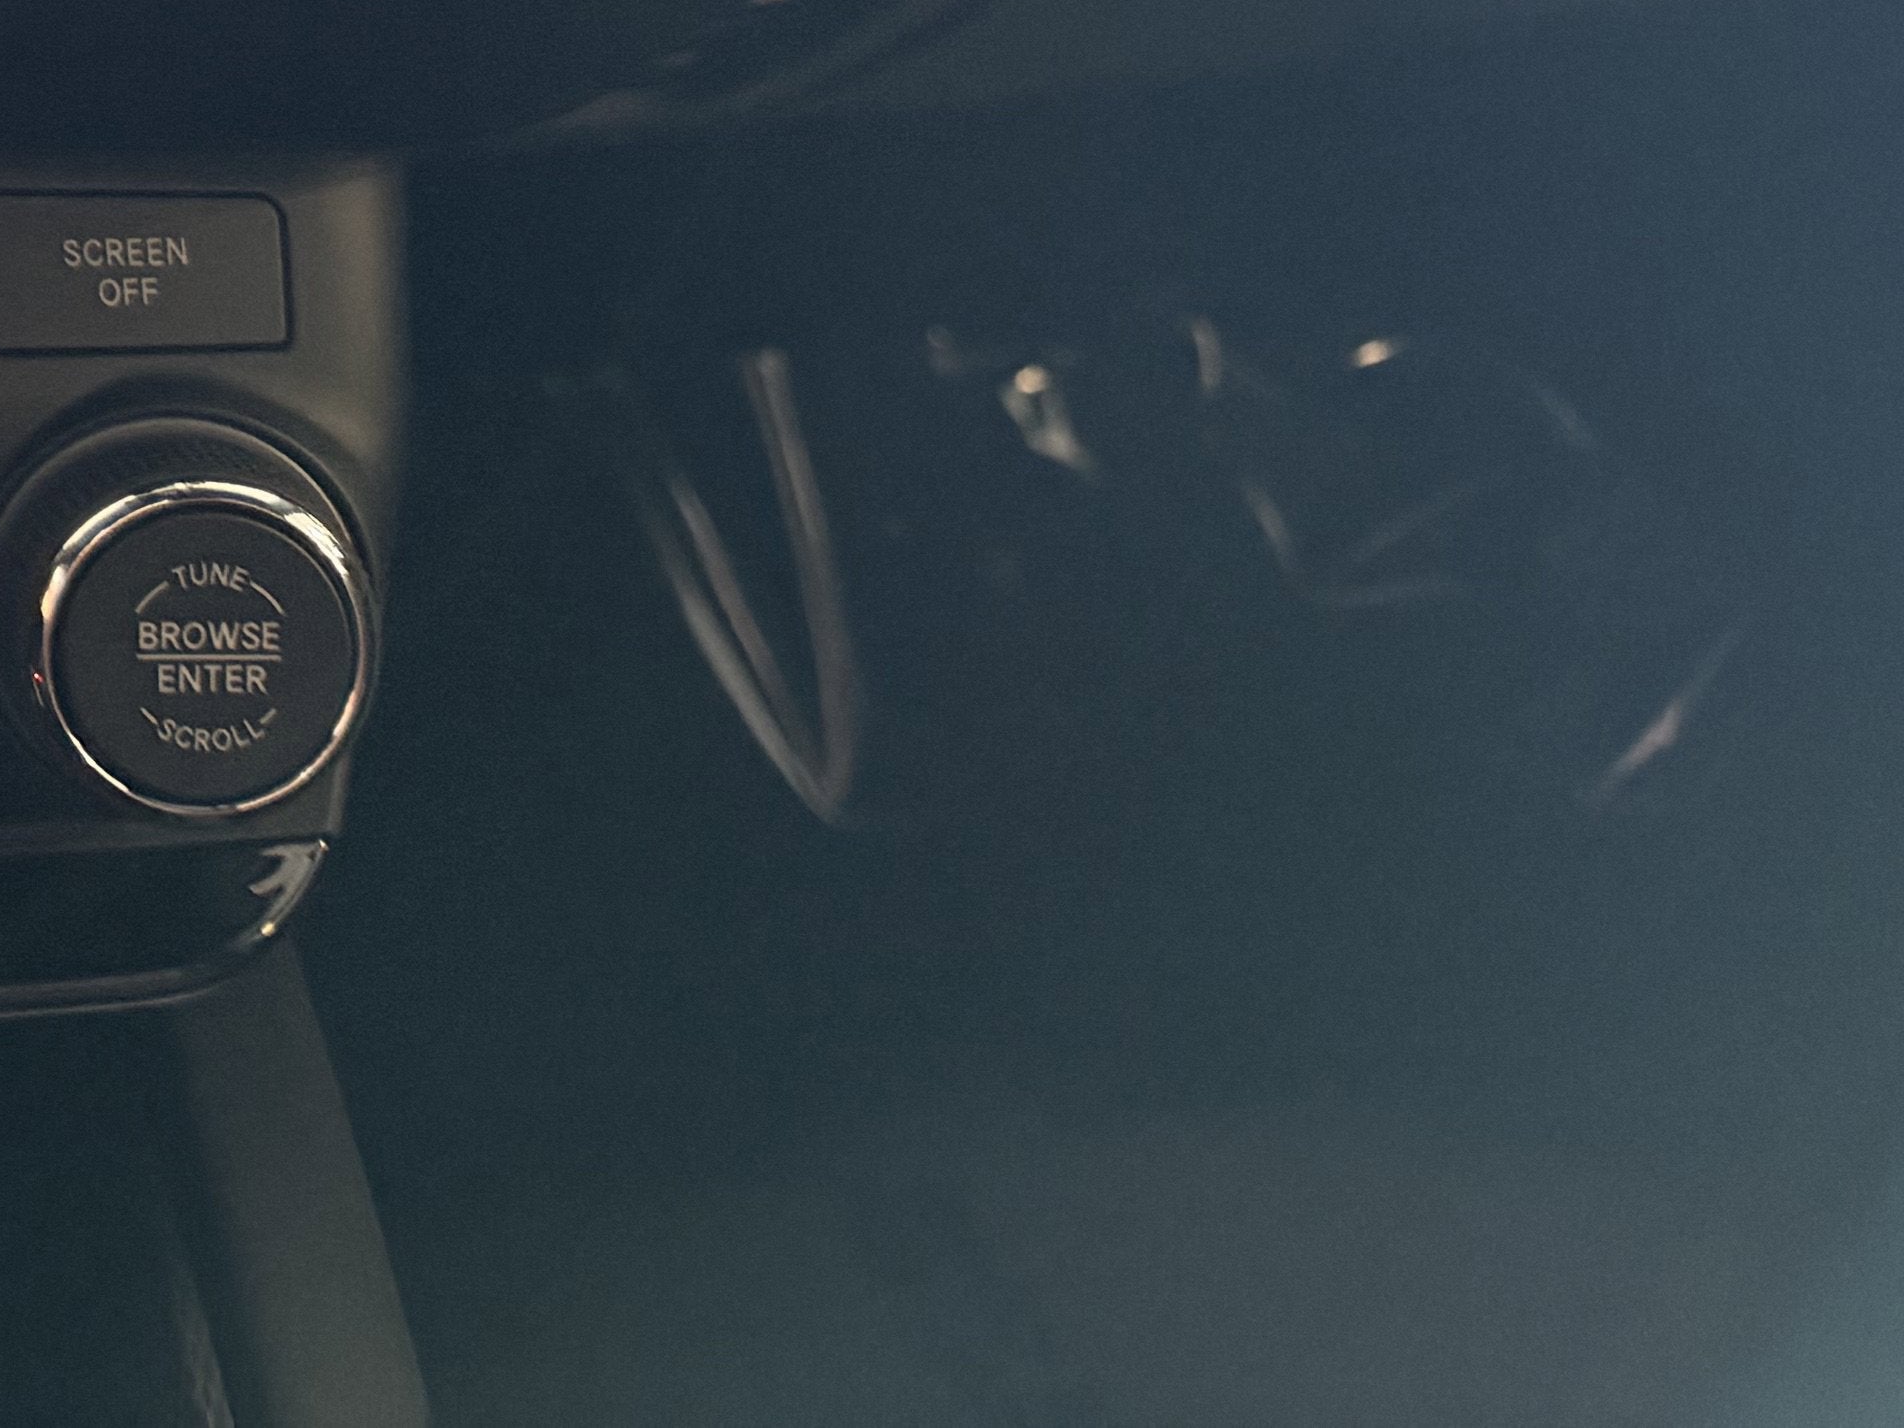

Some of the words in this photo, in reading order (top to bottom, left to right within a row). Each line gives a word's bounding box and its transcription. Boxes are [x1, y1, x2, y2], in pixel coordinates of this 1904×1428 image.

[61, 236, 189, 268] SCREEN
[97, 277, 160, 308] OFF
[170, 560, 252, 592] TUNE
[137, 619, 281, 652] BROWSE
[156, 663, 269, 695] ENTER
[155, 716, 268, 753] SCROLL
